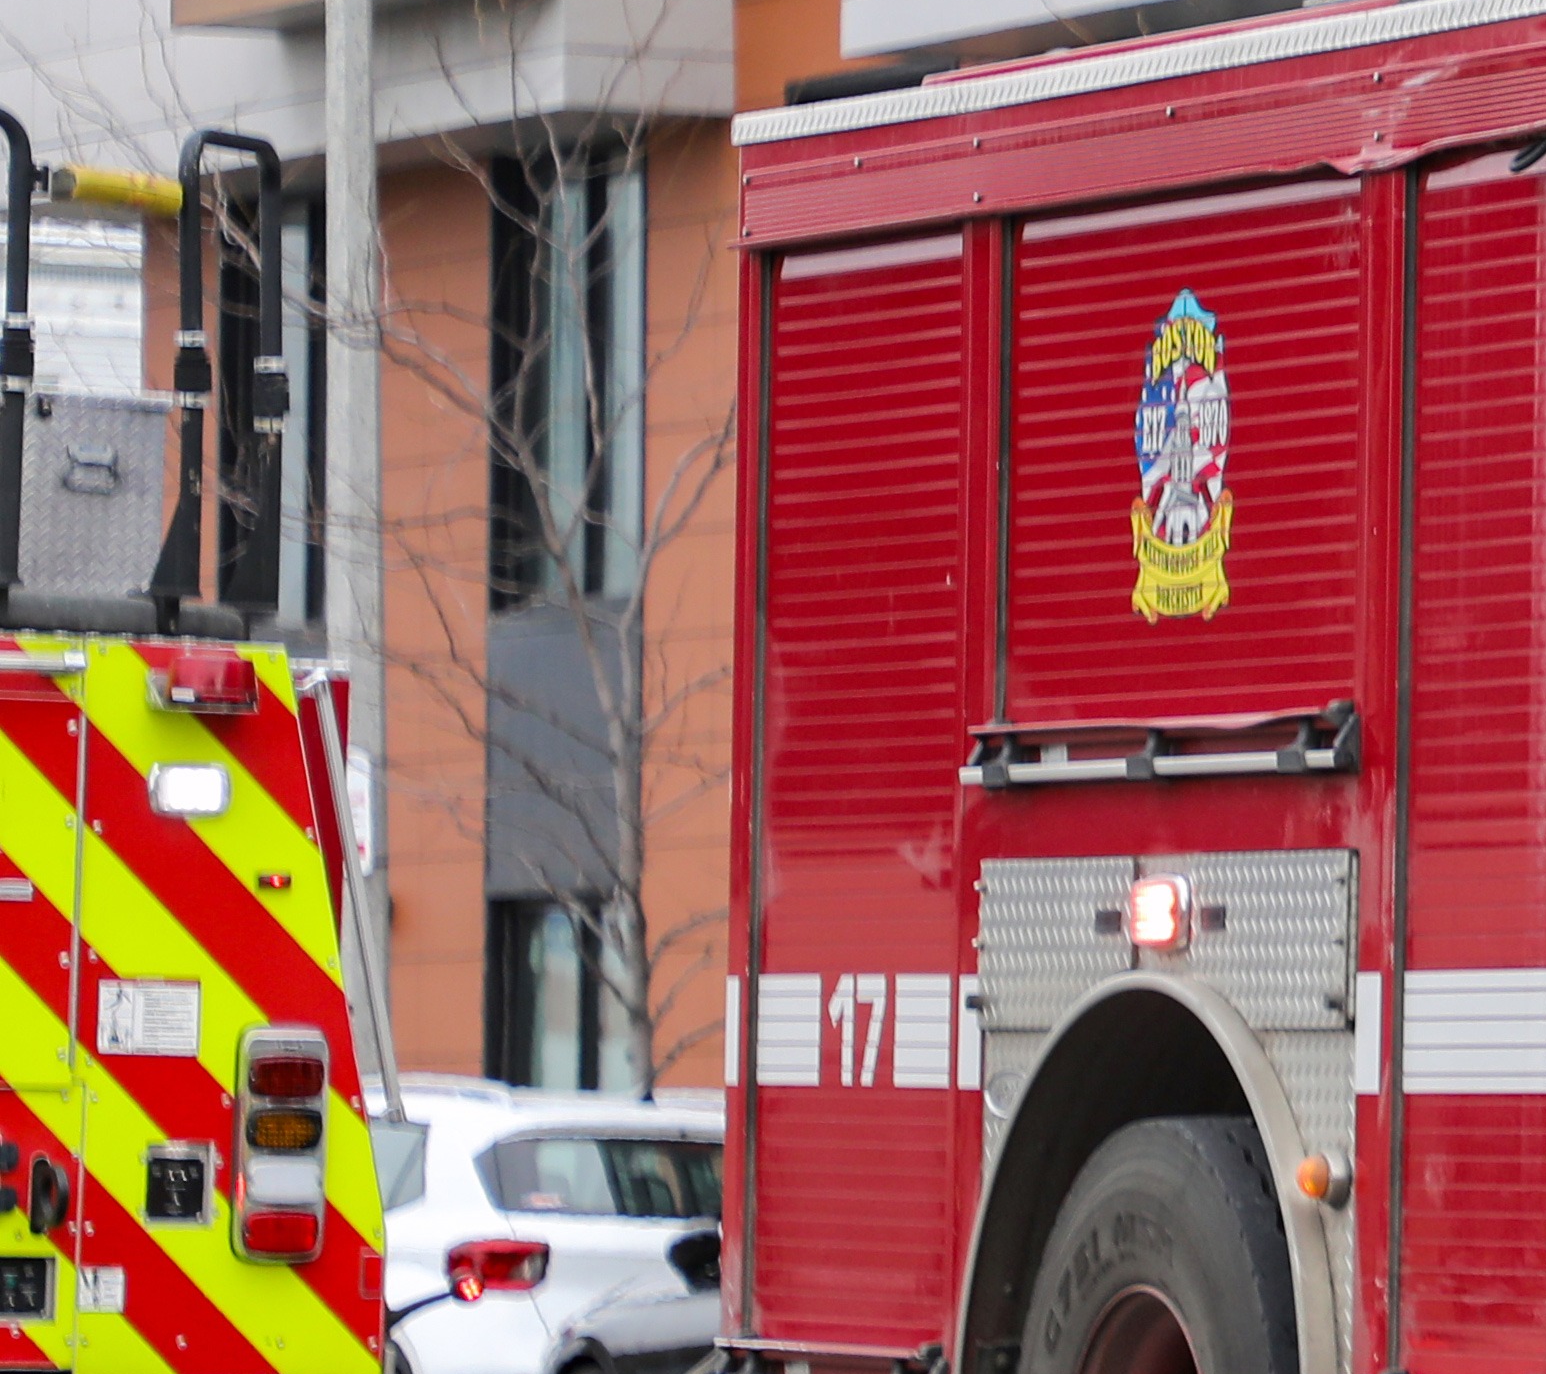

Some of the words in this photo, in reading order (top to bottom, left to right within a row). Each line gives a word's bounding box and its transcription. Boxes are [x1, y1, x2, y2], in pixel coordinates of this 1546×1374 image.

[1152, 317, 1216, 383] BOSTON
[1142, 405, 1167, 453] E17
[1200, 399, 1228, 447] 1870
[828, 973, 887, 1088] 17
